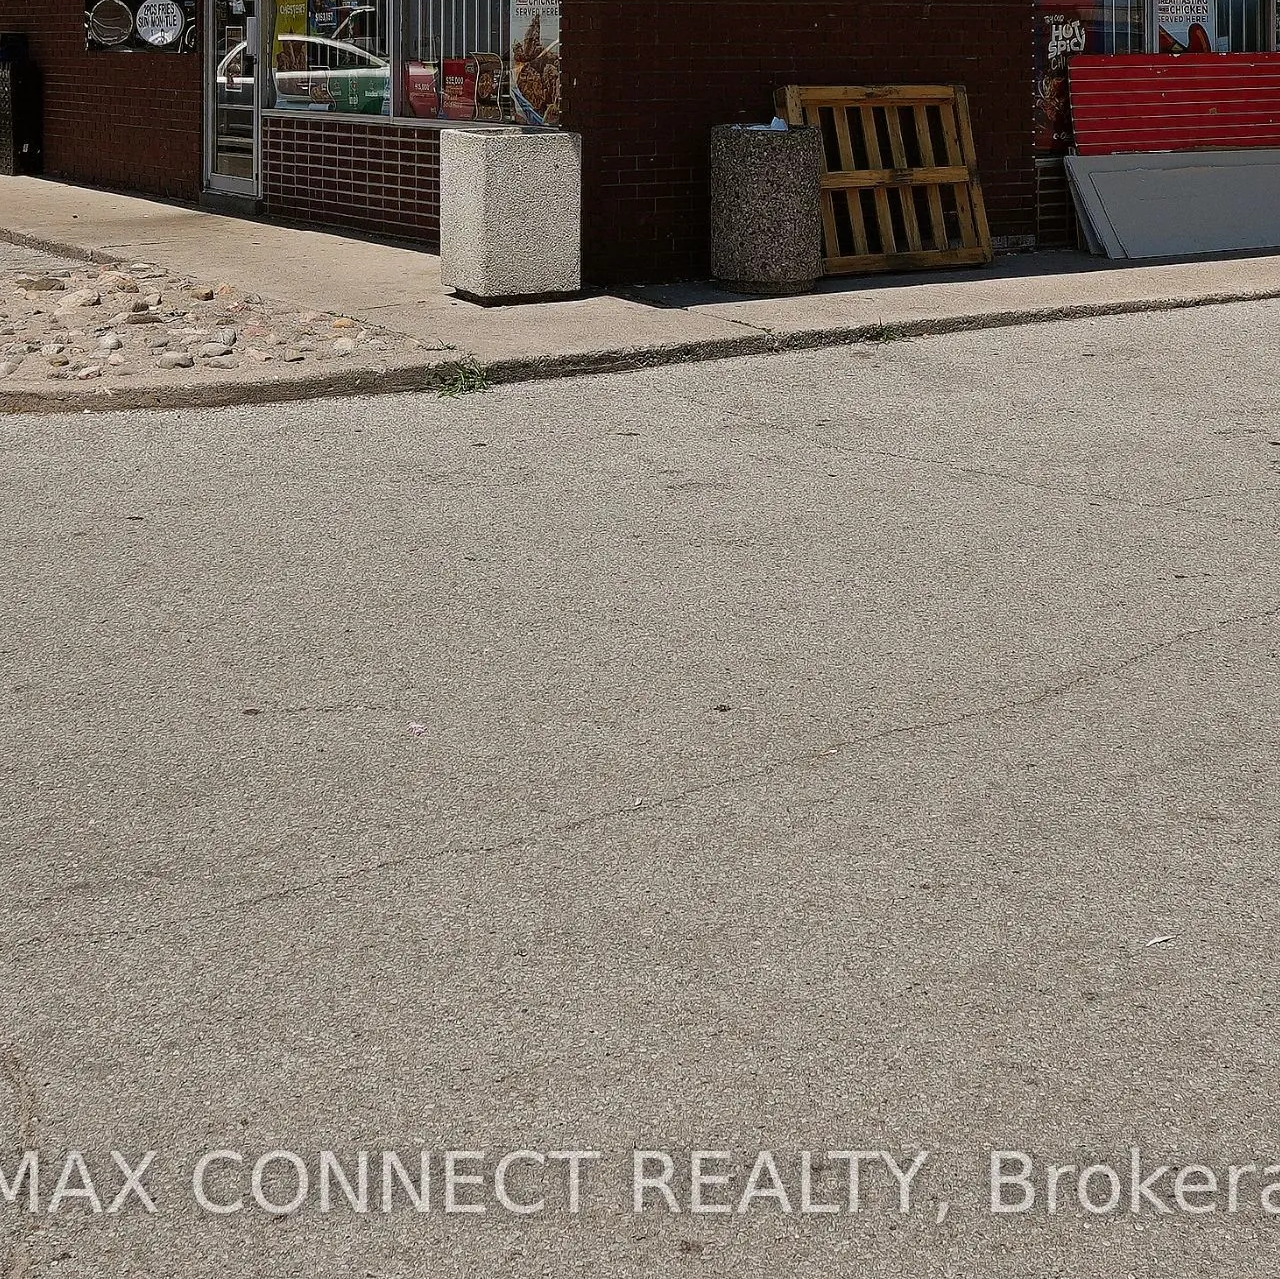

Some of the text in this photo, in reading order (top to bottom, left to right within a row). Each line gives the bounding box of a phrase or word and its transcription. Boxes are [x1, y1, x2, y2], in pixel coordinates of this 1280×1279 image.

[516, 7, 540, 16] SERVED
[1170, 5, 1208, 14] CHICKEN
[1052, 21, 1081, 41] HOT
